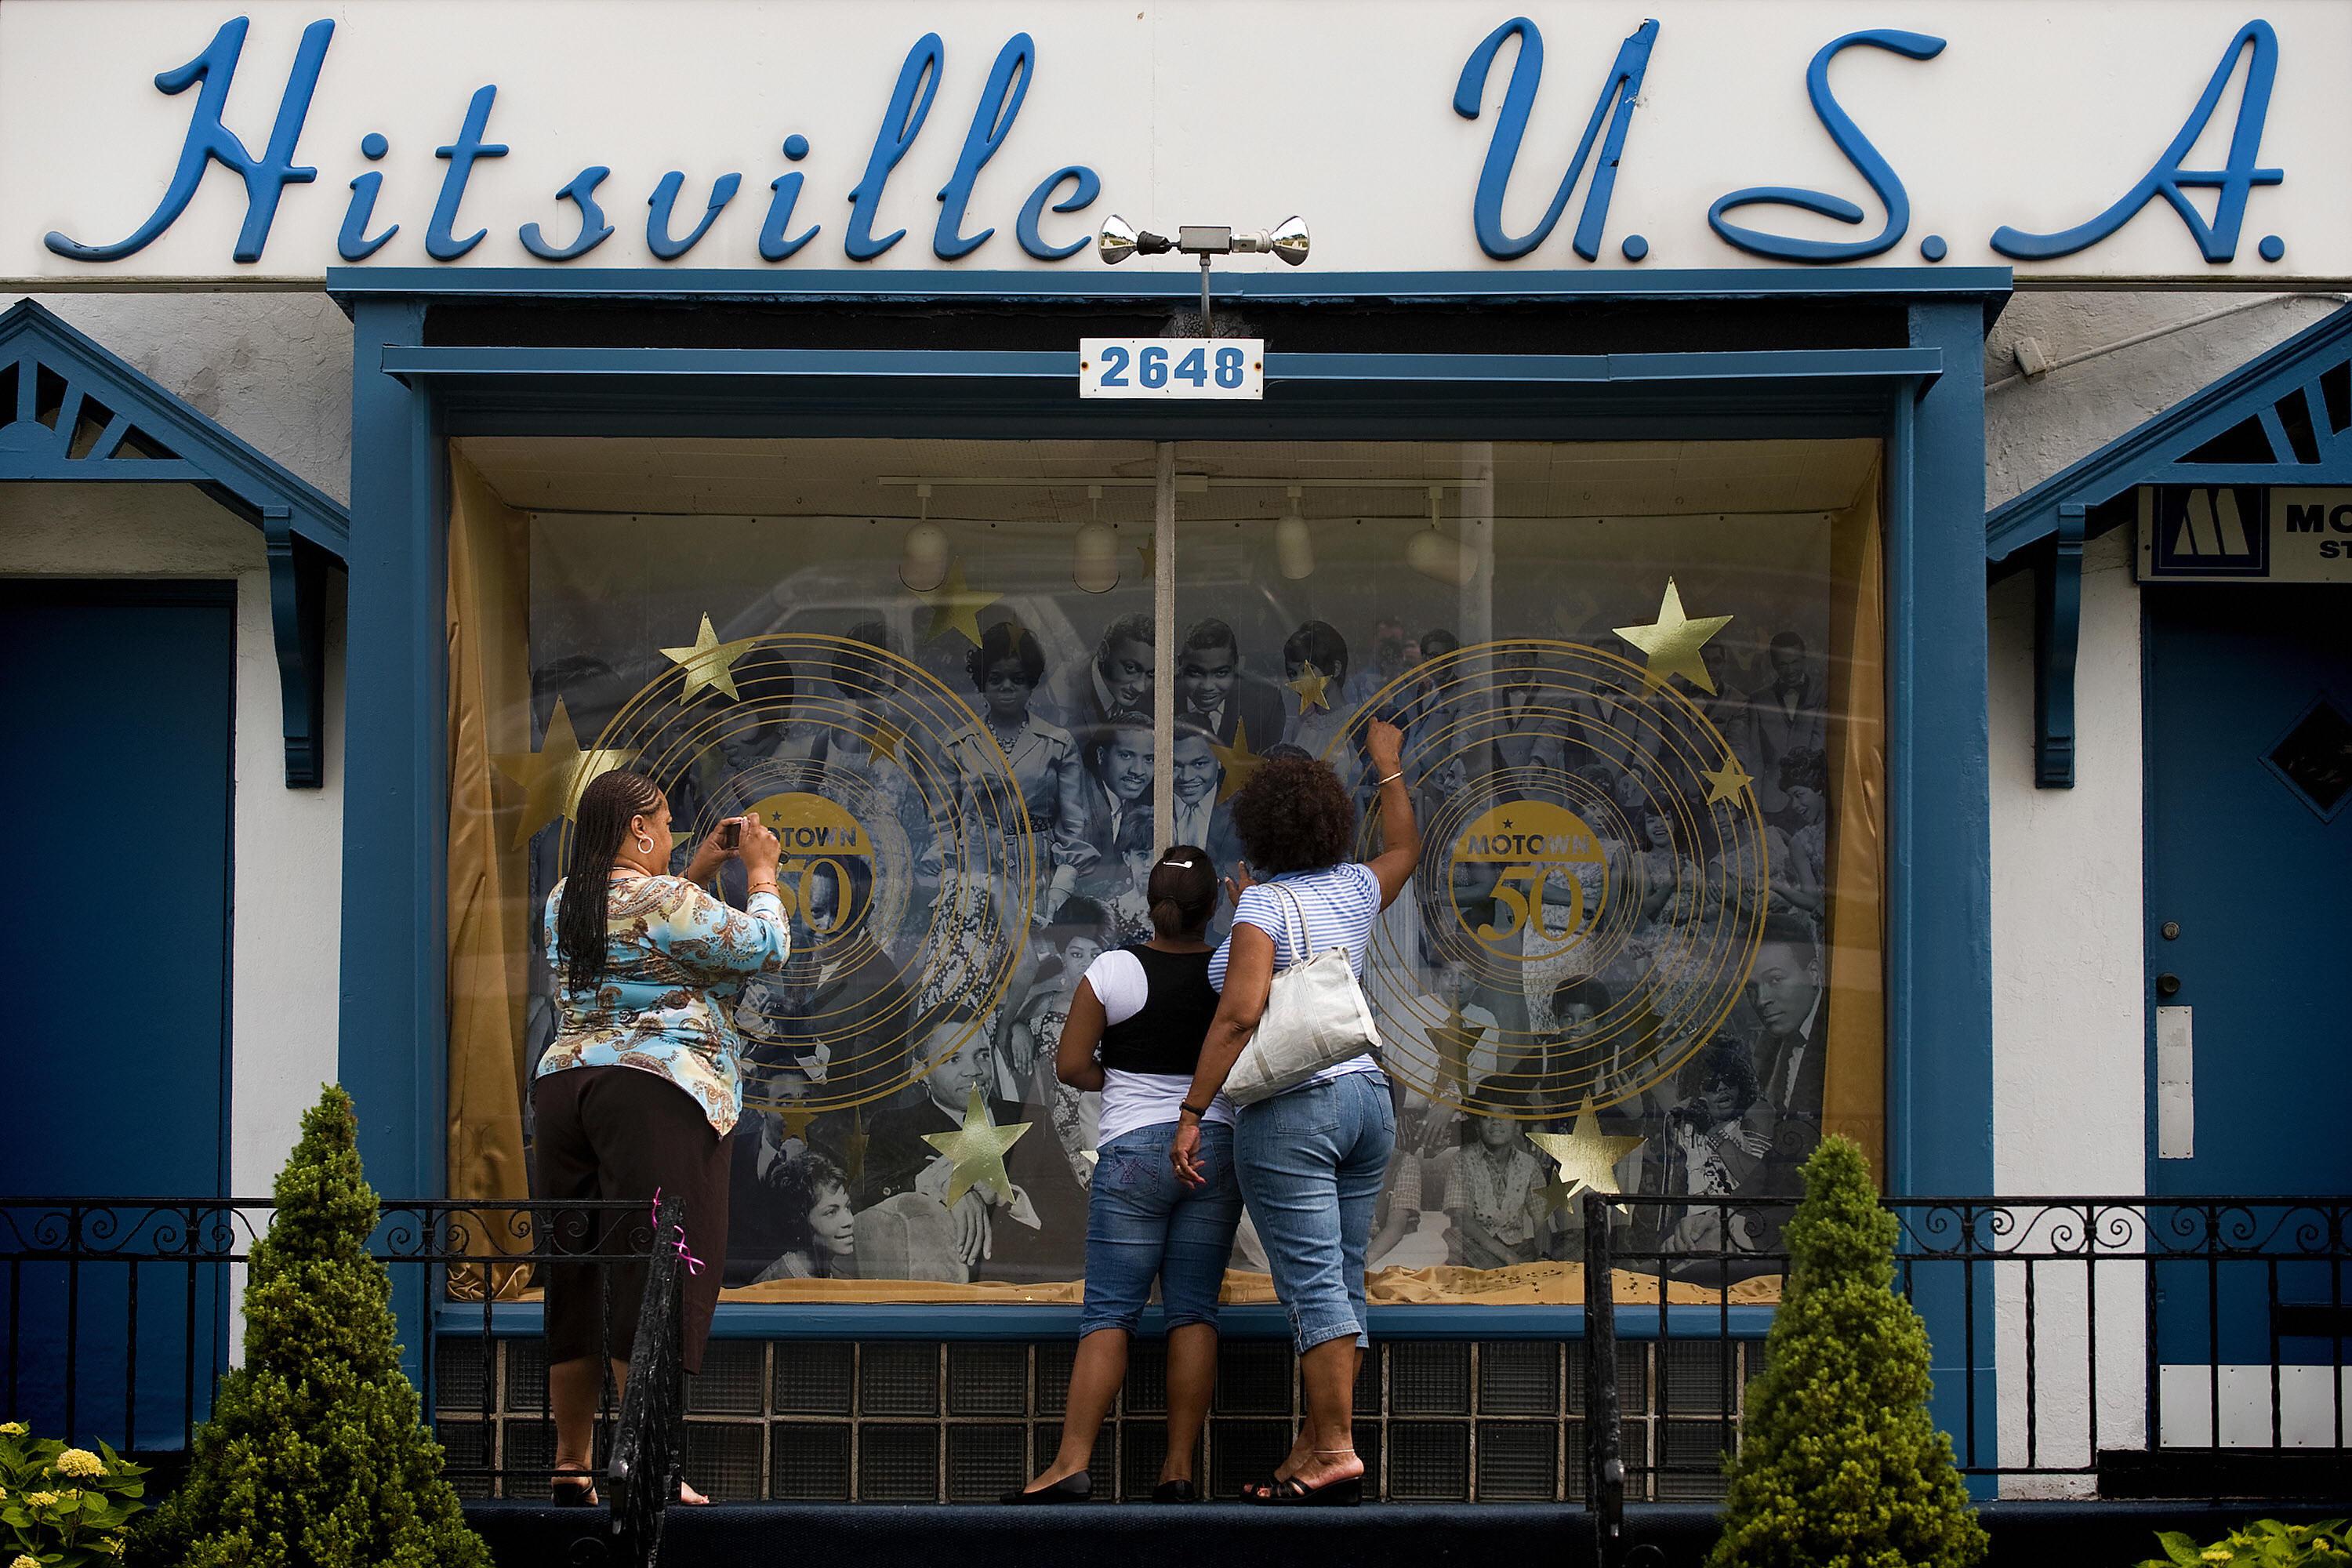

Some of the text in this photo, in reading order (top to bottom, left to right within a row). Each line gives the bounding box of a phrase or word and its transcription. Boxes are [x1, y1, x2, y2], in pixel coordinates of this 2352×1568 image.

[43, 16, 1100, 263] Hitsville
[1100, 346, 1244, 389] 2648
[768, 827, 856, 848] TOWN
[1467, 834, 1590, 855] MOTOWN
[1478, 865, 1584, 941] 50
